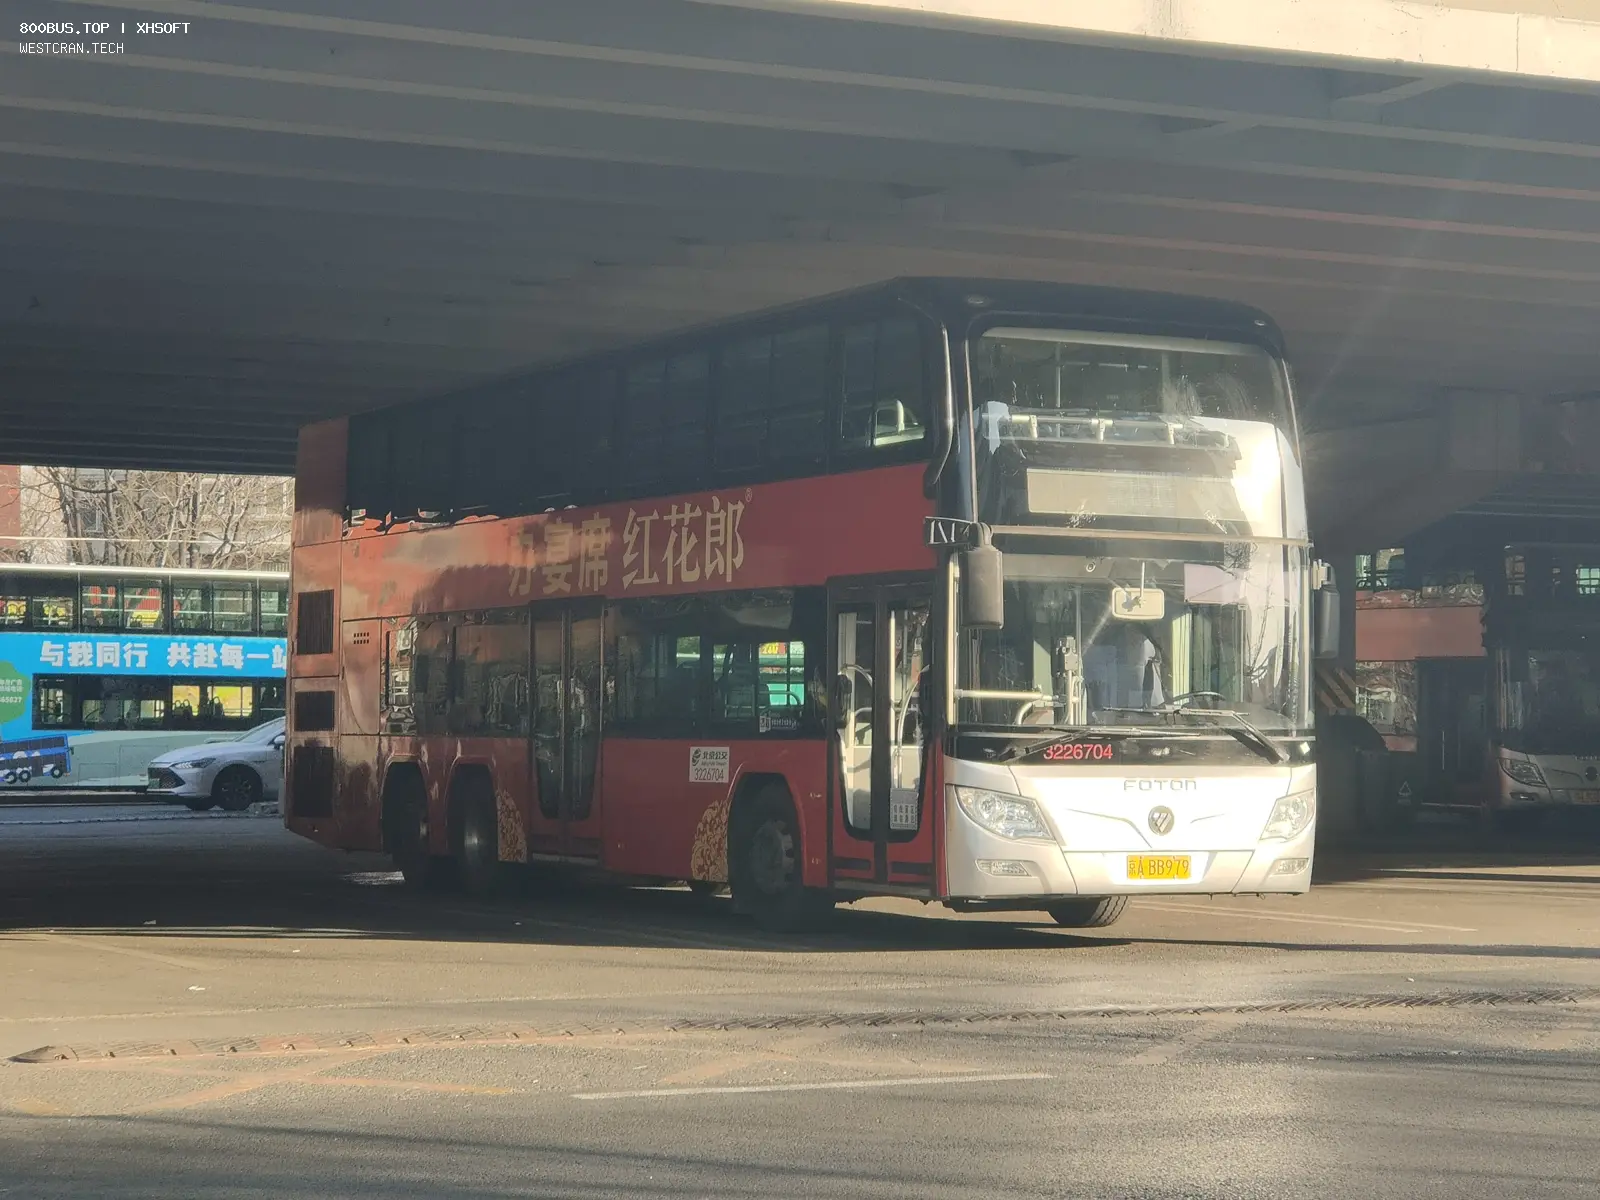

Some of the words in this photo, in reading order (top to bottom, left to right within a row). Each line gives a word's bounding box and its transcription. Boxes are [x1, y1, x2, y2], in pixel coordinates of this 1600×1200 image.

[622, 495, 745, 590] 红花郎
[40, 641, 149, 668] 与我同行
[1042, 743, 1114, 760] 3226704
[693, 768, 725, 781] 3226704
[1123, 779, 1197, 791] FOTON
